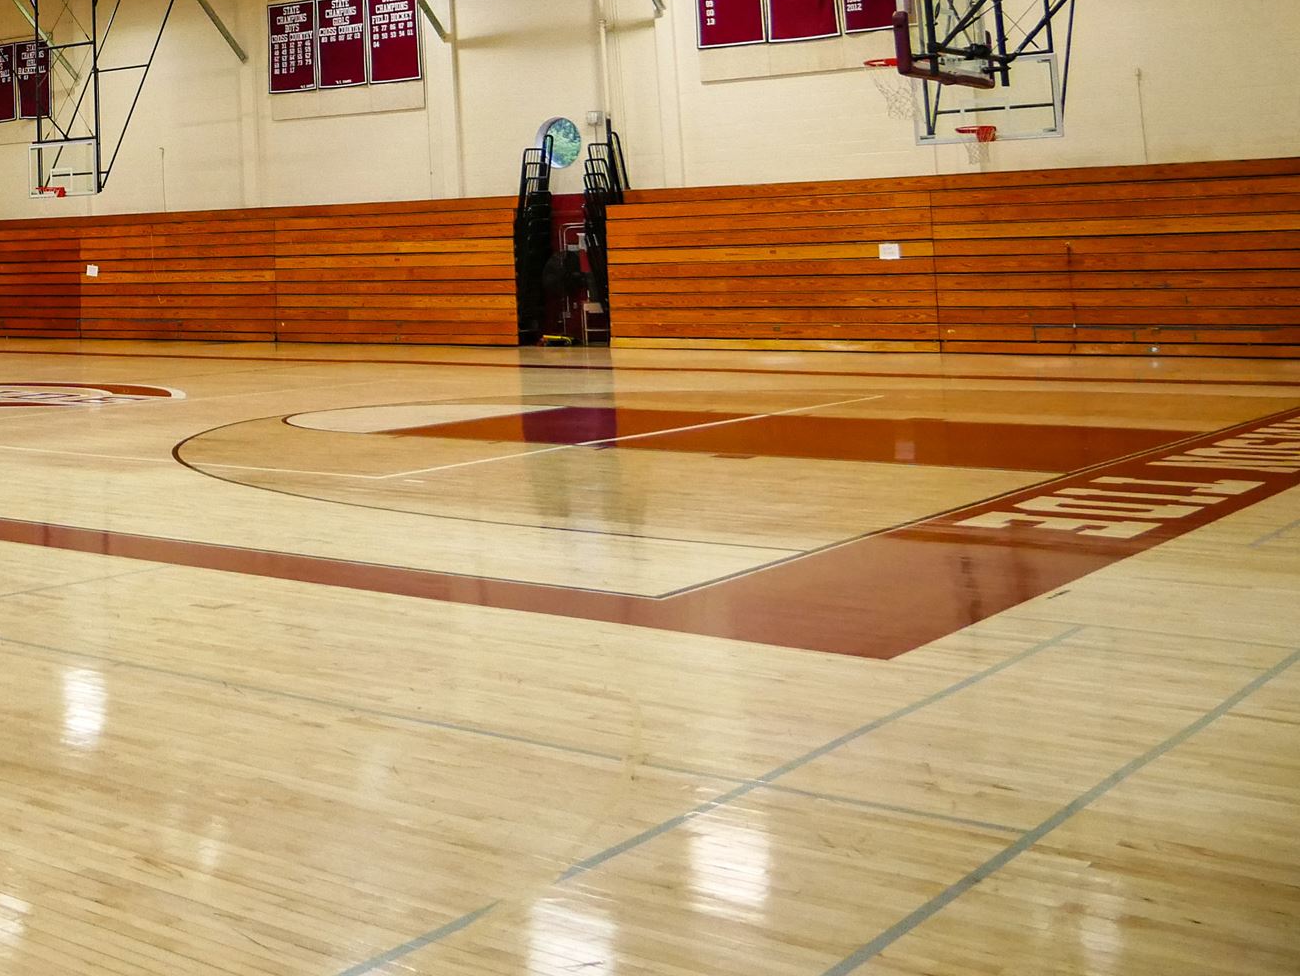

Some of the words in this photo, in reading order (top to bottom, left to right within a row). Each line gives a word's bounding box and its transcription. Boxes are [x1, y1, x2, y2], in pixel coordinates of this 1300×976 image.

[283, 5, 300, 15] STATE
[325, 6, 357, 18] CHAMPIONS
[375, 0, 409, 14] CHAMPIONS
[276, 13, 307, 25] CHAMPIONS
[332, 16, 350, 26] GIRLS
[371, 14, 389, 25] FIELD
[390, 11, 413, 22] HOCKEY
[284, 24, 300, 33] BOYS
[319, 27, 337, 36] CROSS
[338, 23, 363, 34] COUNTRY
[271, 34, 288, 44] CROSS
[289, 30, 313, 41] COUNTRY
[951, 476, 1266, 539] TIDE
